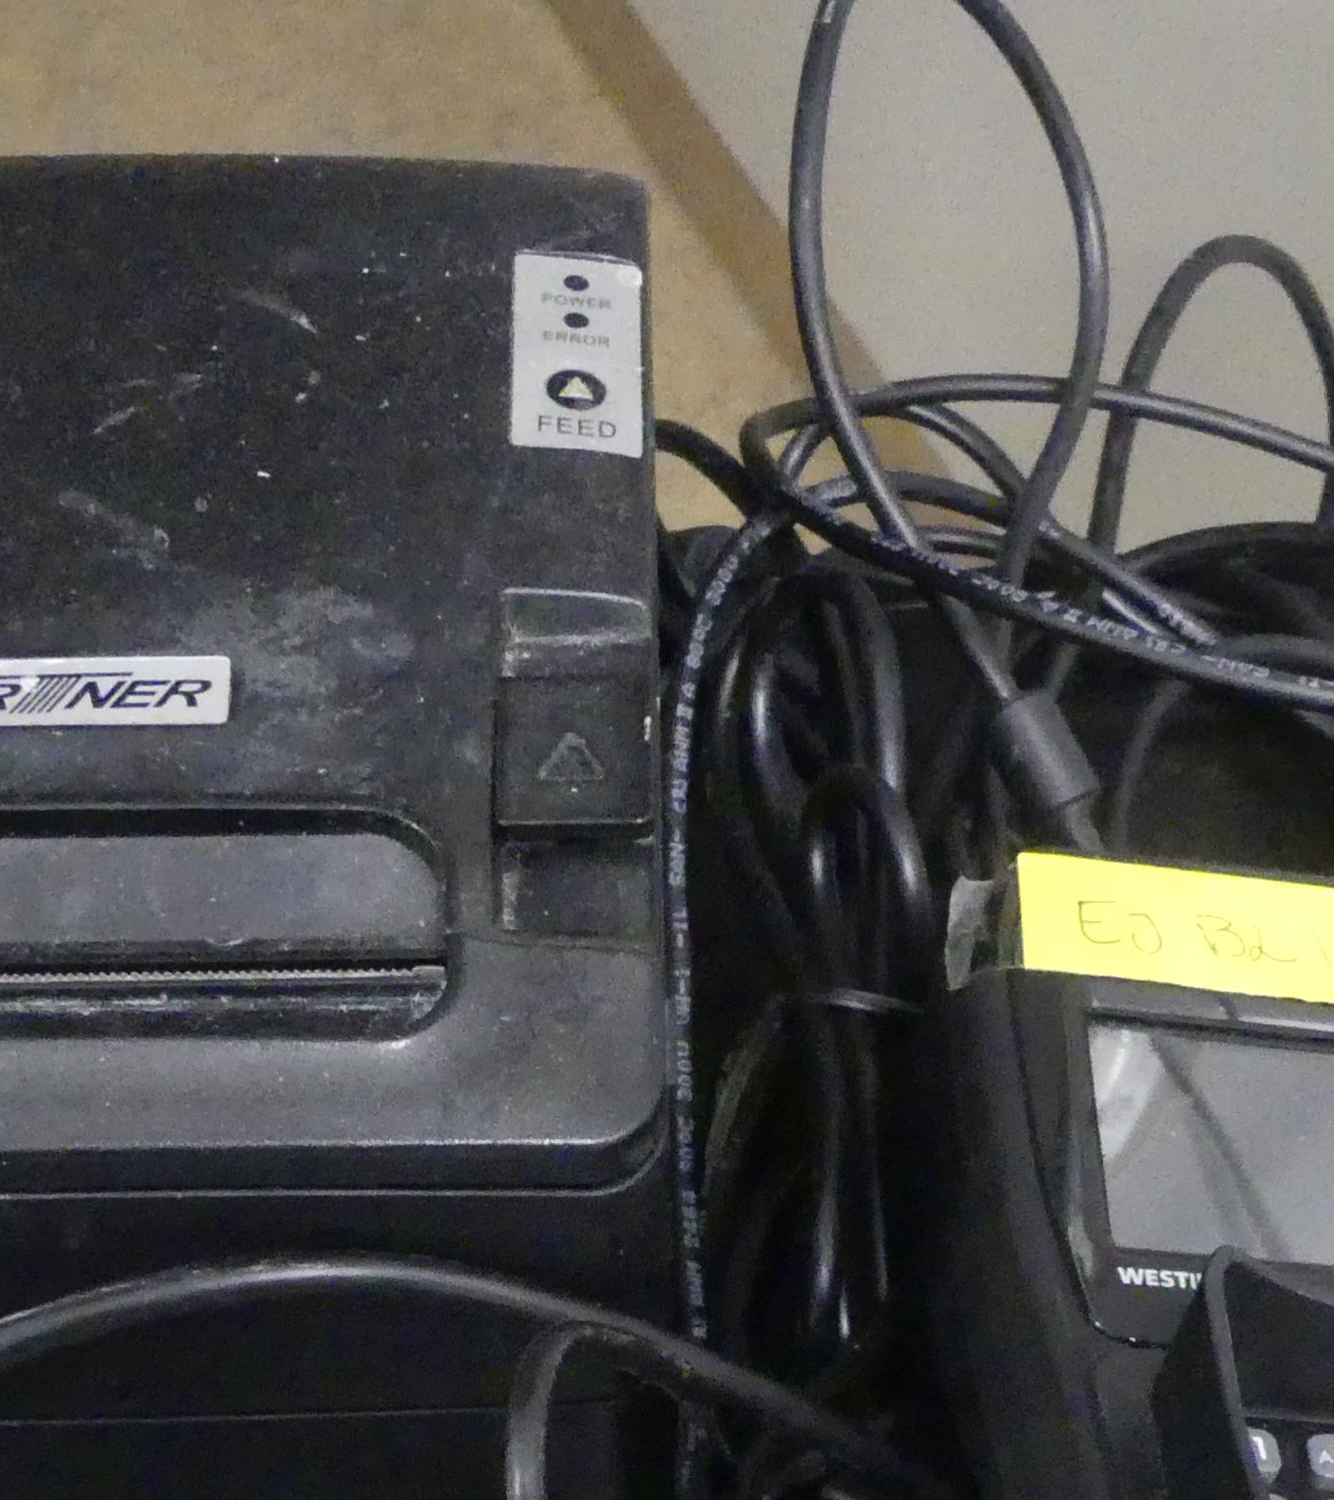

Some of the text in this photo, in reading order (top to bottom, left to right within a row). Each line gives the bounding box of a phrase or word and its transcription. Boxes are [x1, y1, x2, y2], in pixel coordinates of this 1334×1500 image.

[542, 292, 612, 310] POWER
[542, 330, 610, 349] ERROR
[537, 414, 617, 438] FEED
